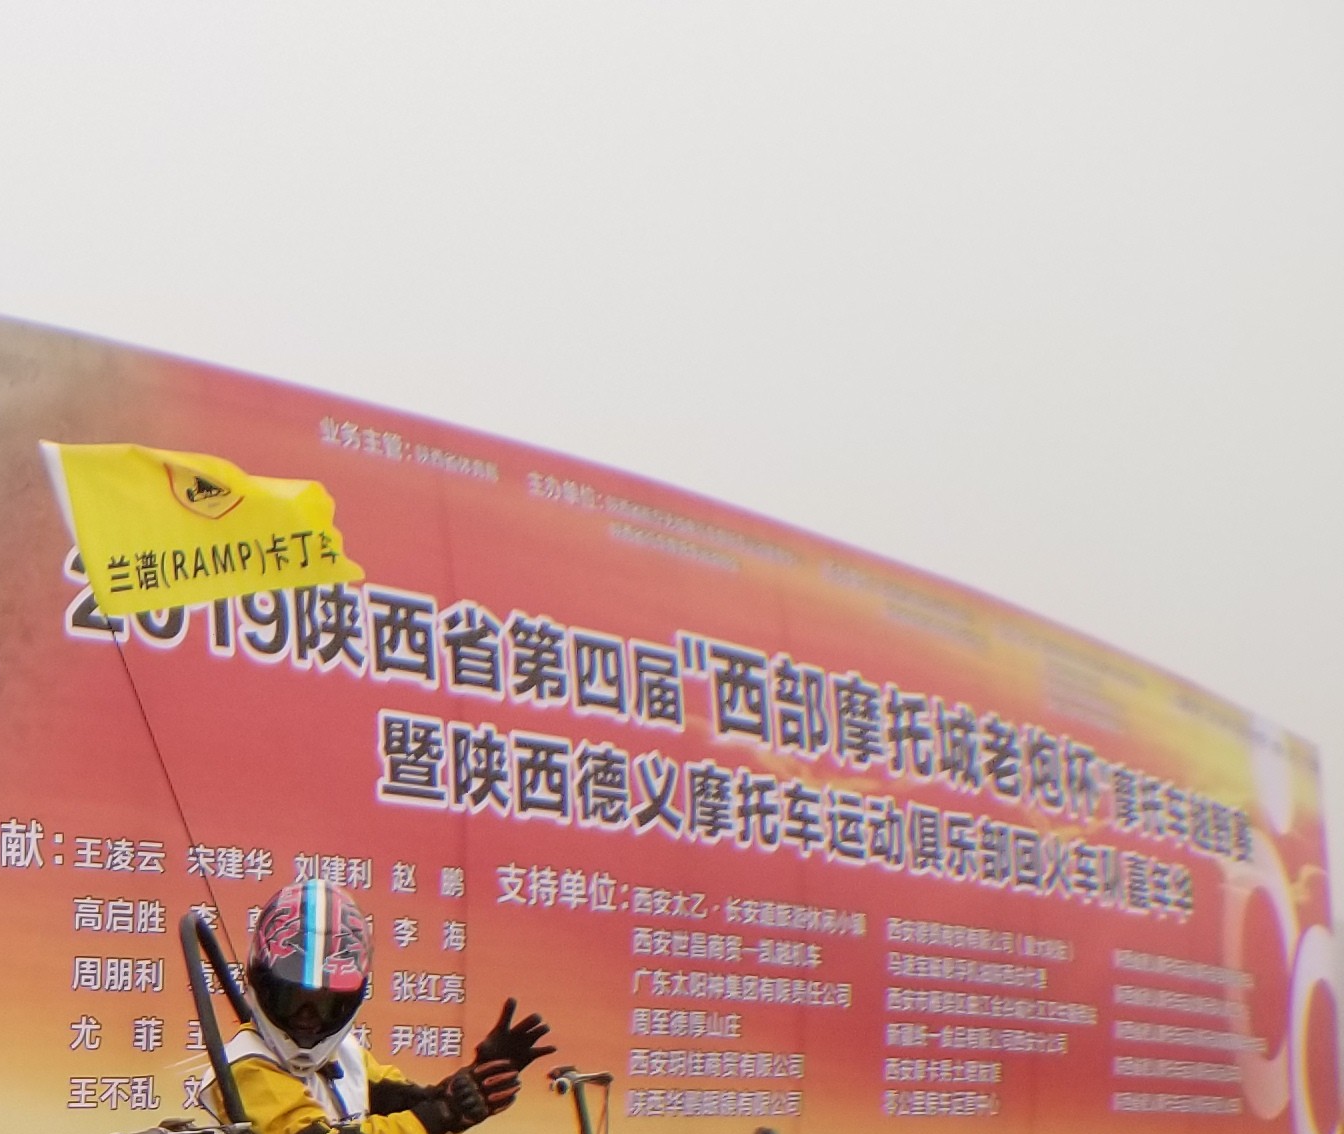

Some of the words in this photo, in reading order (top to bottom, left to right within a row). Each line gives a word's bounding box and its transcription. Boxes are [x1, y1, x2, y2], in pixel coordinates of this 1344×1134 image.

[73, 836, 166, 873] 王凌云
[187, 843, 273, 882] 宋建华
[294, 852, 373, 890] 刘建利
[73, 896, 167, 933] 高启胜
[72, 956, 165, 993] 周朋利
[392, 970, 466, 1004] 张红亮
[391, 1024, 464, 1057] 尹湘君
[67, 1074, 161, 1110] 王不乱
